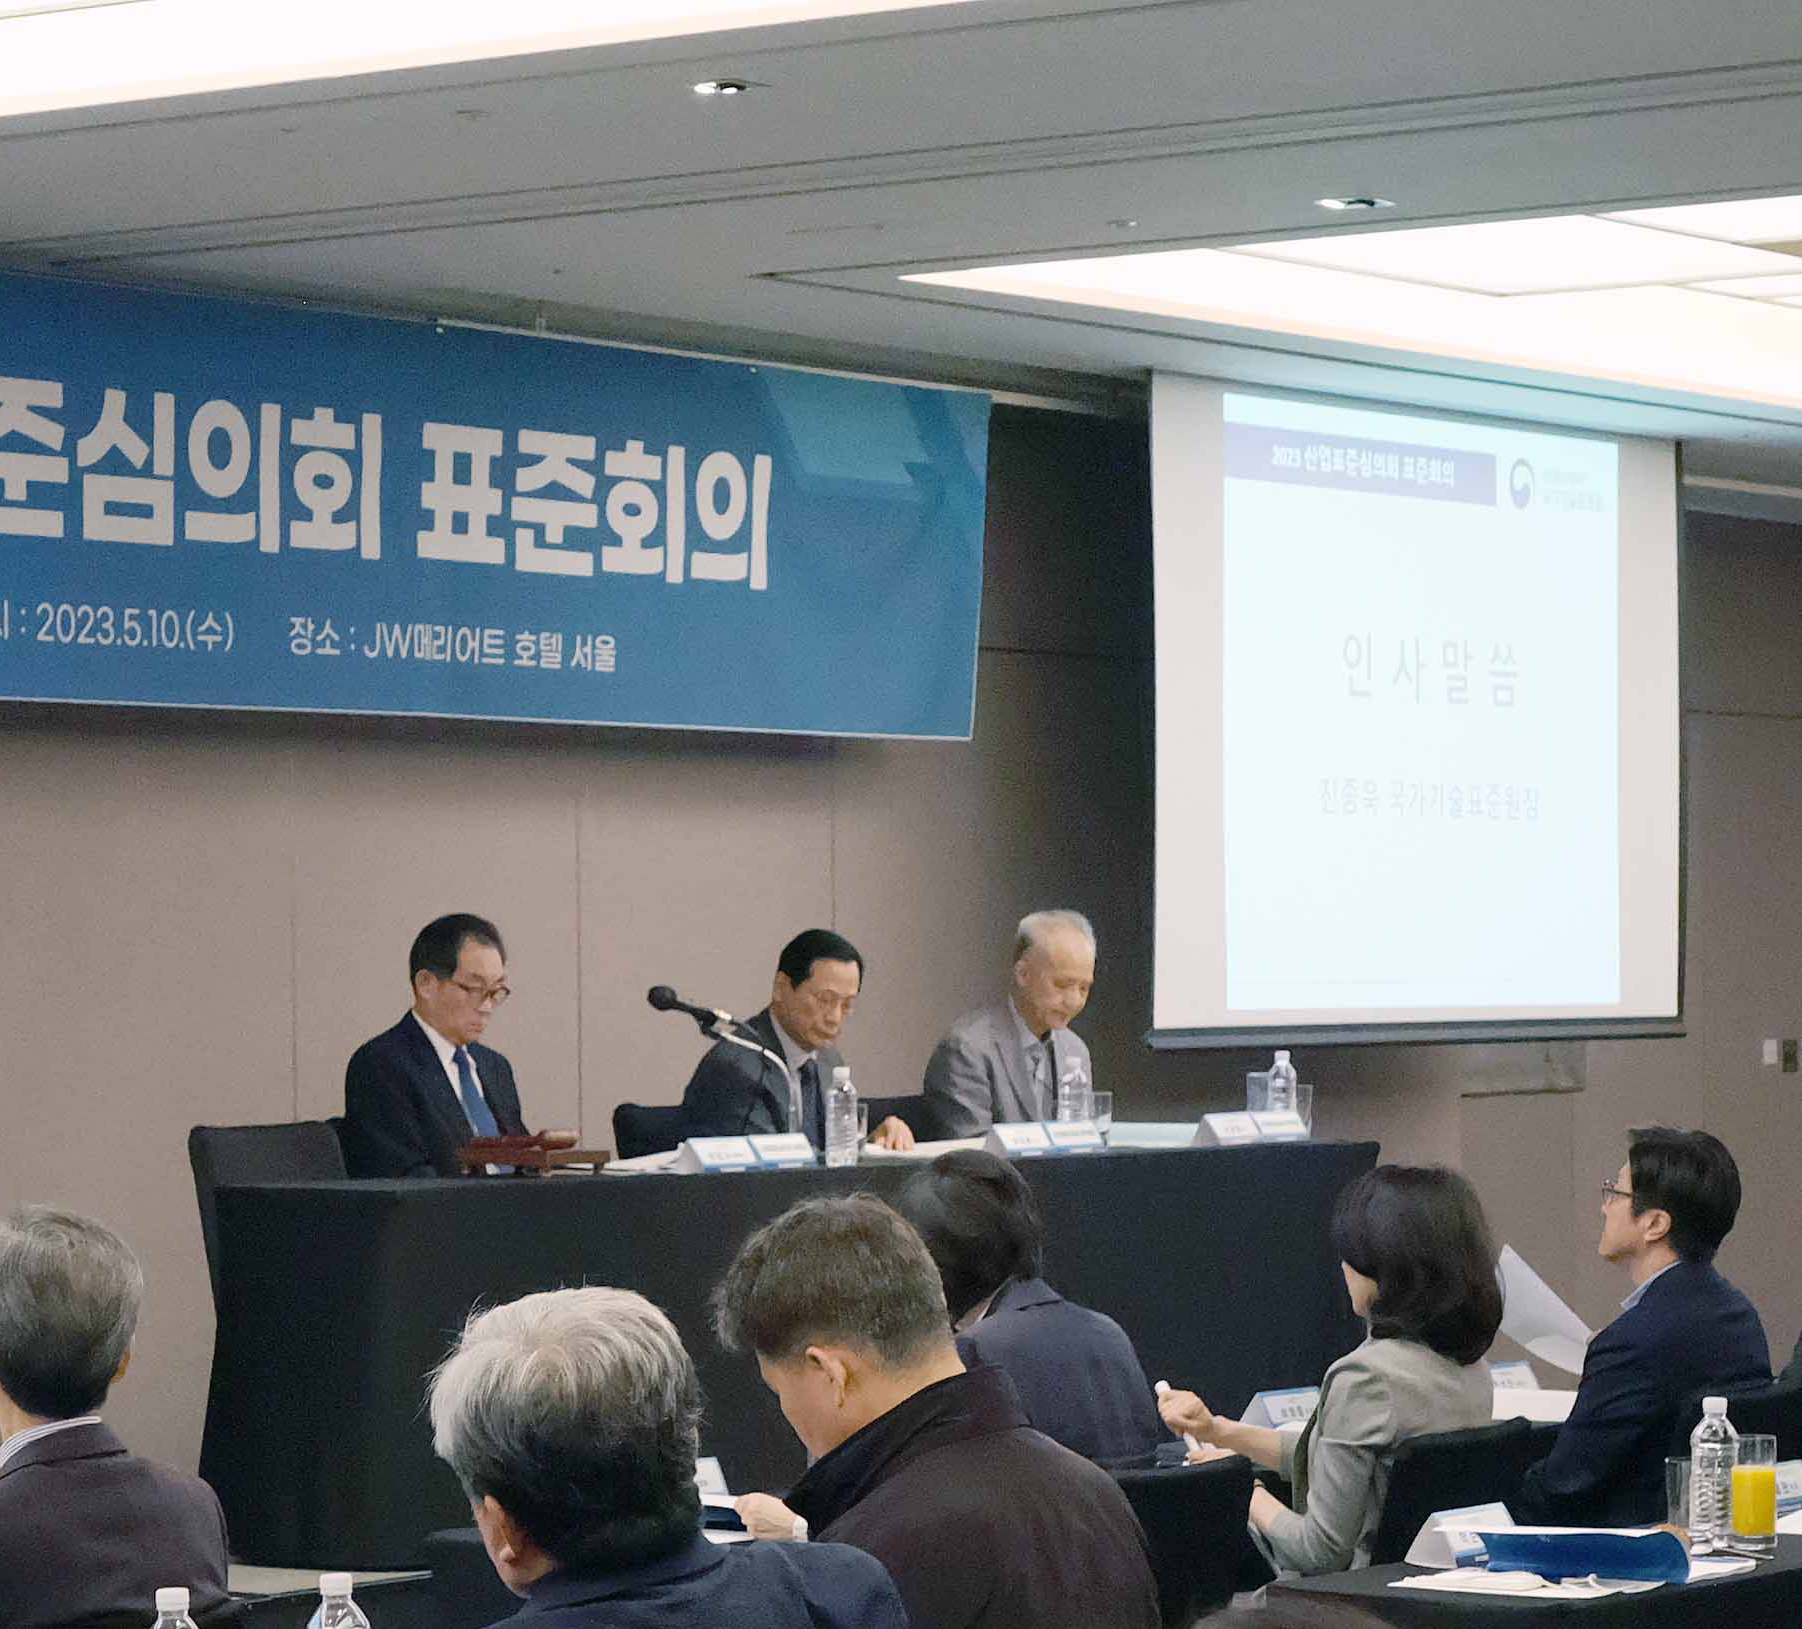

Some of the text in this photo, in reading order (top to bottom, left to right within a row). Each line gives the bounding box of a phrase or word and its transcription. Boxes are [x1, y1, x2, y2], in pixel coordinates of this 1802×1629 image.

[417, 421, 773, 591] 표준회의
[36, 604, 234, 652] 2023.5.10.(수)
[289, 616, 341, 657] 장소
[364, 622, 505, 667] JW메리어트
[513, 630, 562, 670] 호텔
[571, 635, 616, 672] 서울
